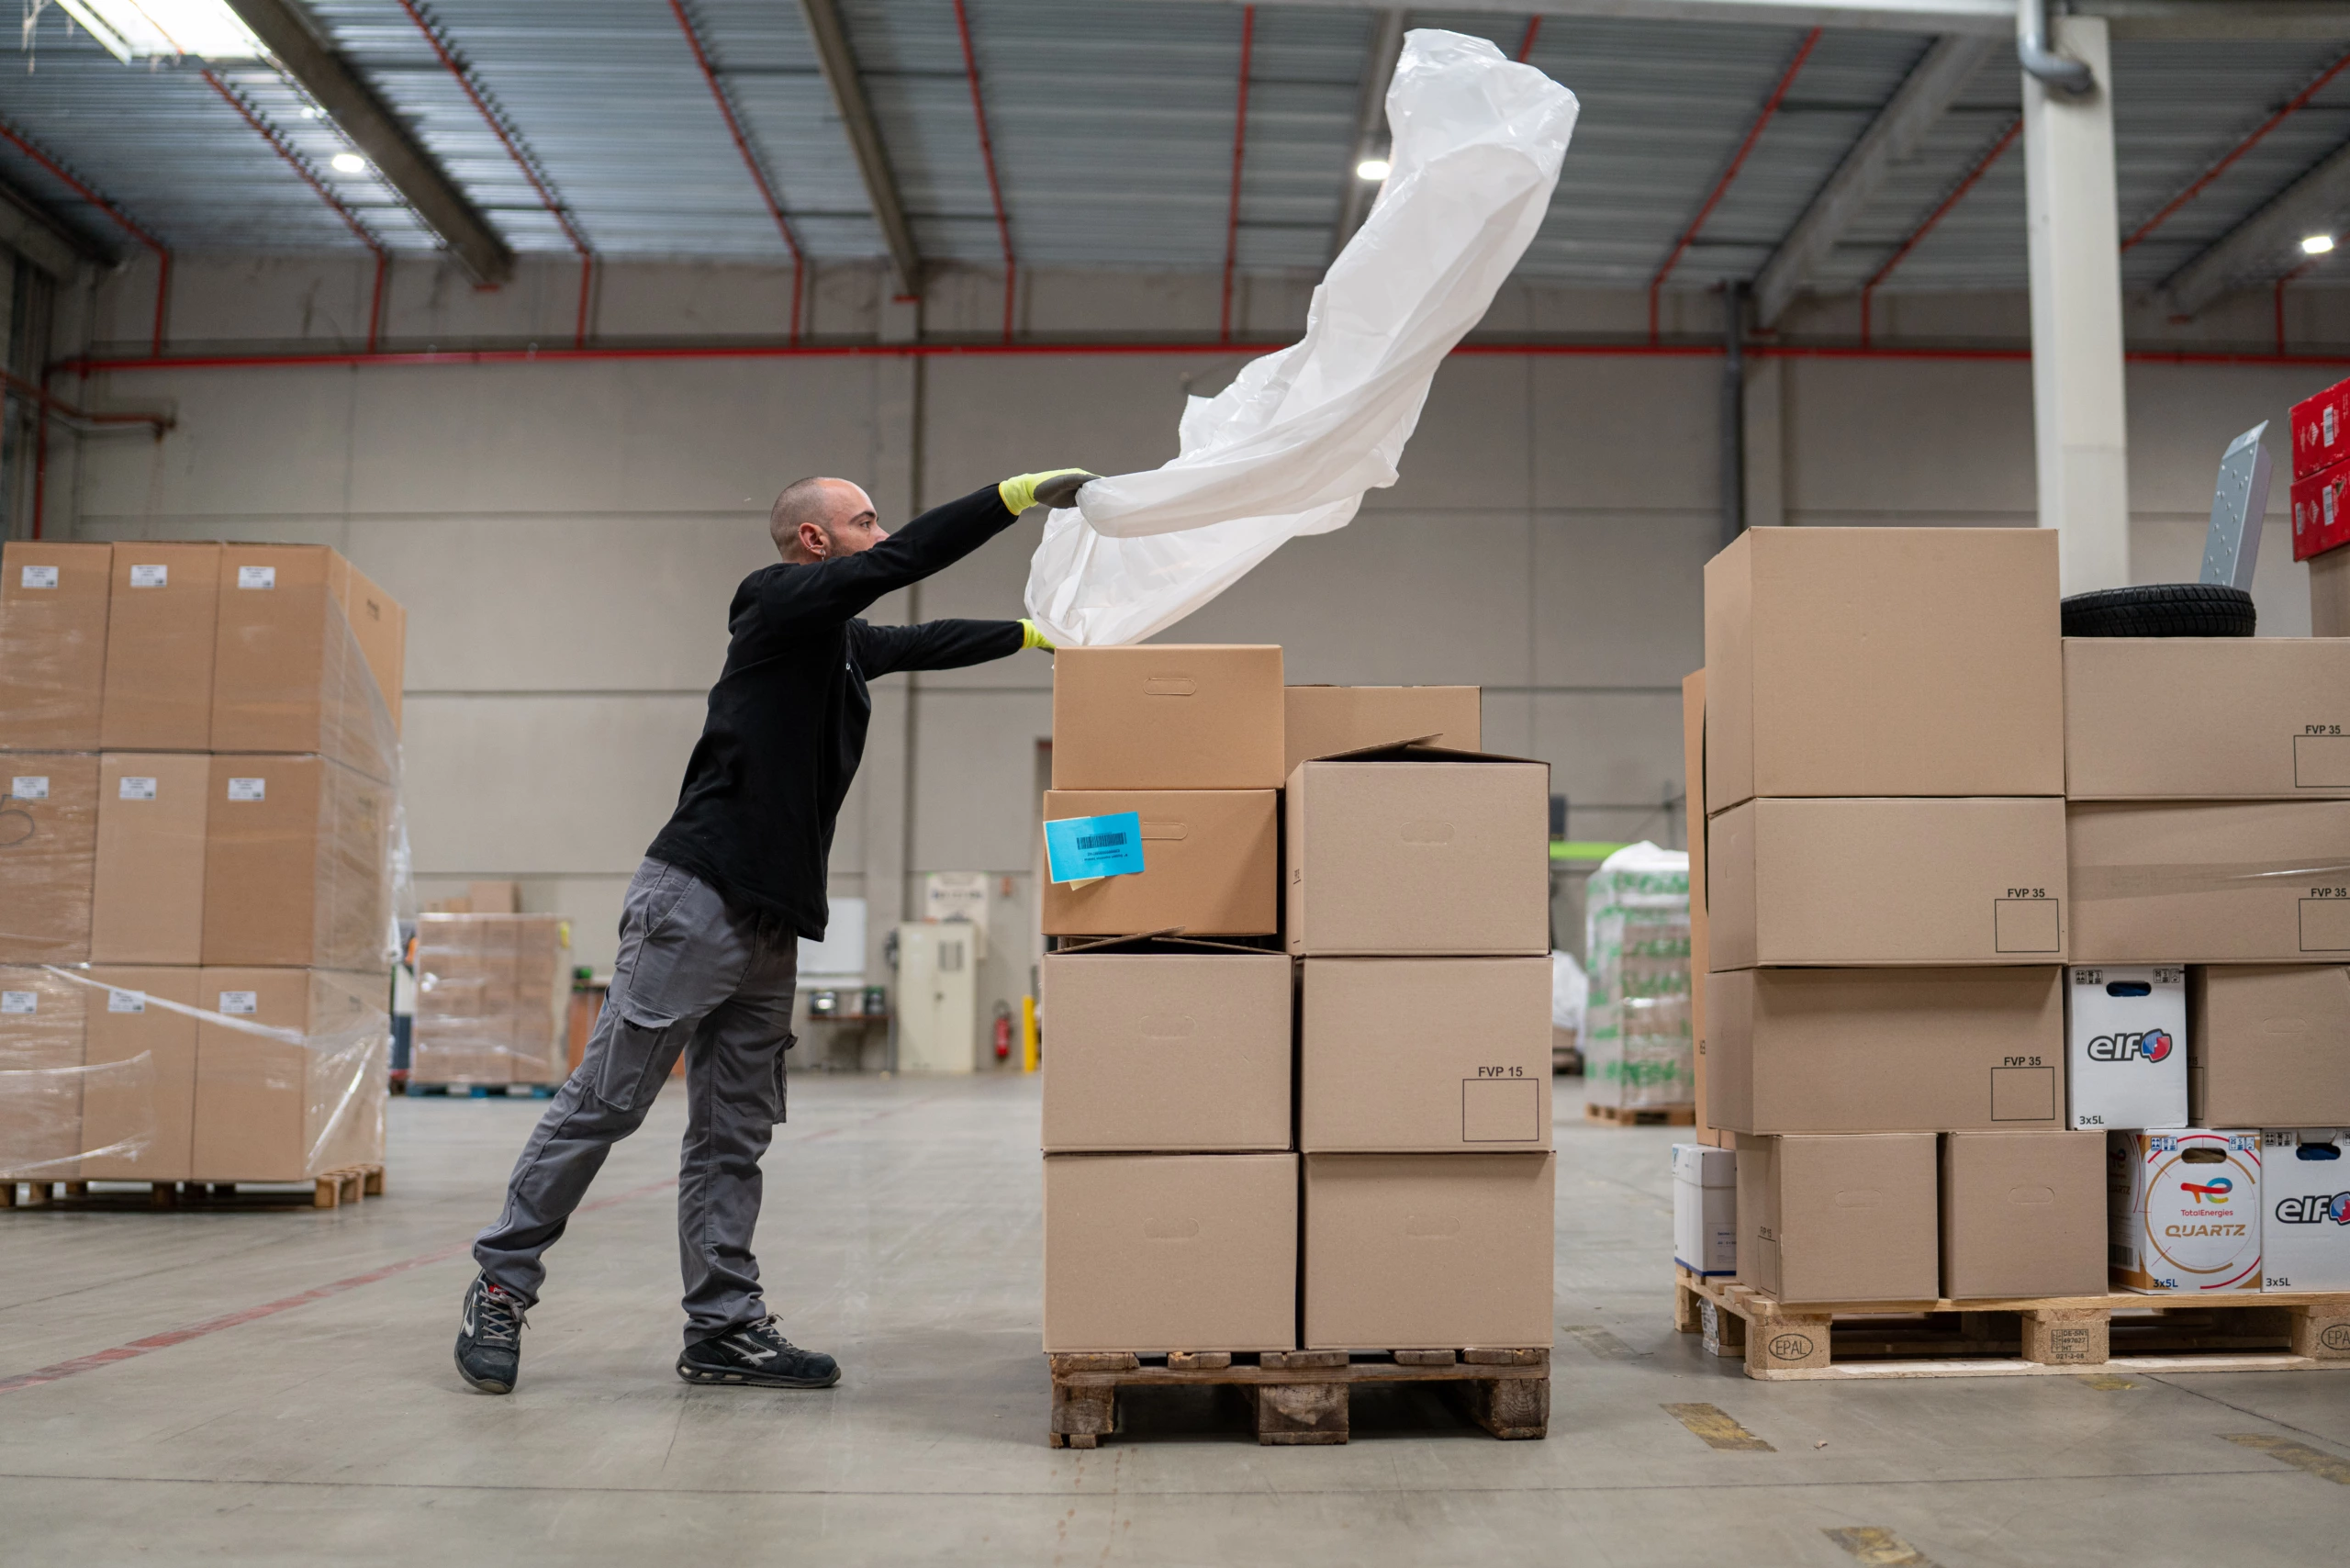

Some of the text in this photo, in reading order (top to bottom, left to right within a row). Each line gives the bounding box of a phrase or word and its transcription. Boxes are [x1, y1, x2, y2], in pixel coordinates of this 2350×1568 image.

[2305, 724, 2341, 734] FVP 35
[2008, 888, 2045, 898] FVP 35
[2311, 888, 2347, 898] FVP 35
[2087, 1032, 2143, 1061] elf
[2004, 1056, 2042, 1066] FVP 35
[1478, 1066, 1523, 1077] FVP 15
[2079, 1115, 2104, 1125] 3x5L
[2181, 1208, 2233, 1218] TotalEnergies
[2276, 1195, 2334, 1224] elf
[2165, 1224, 2247, 1238] QUARTZ
[2153, 1278, 2179, 1288] 3x5L
[2266, 1277, 2291, 1287] 3x5L
[1776, 1340, 1807, 1355] EPAL
